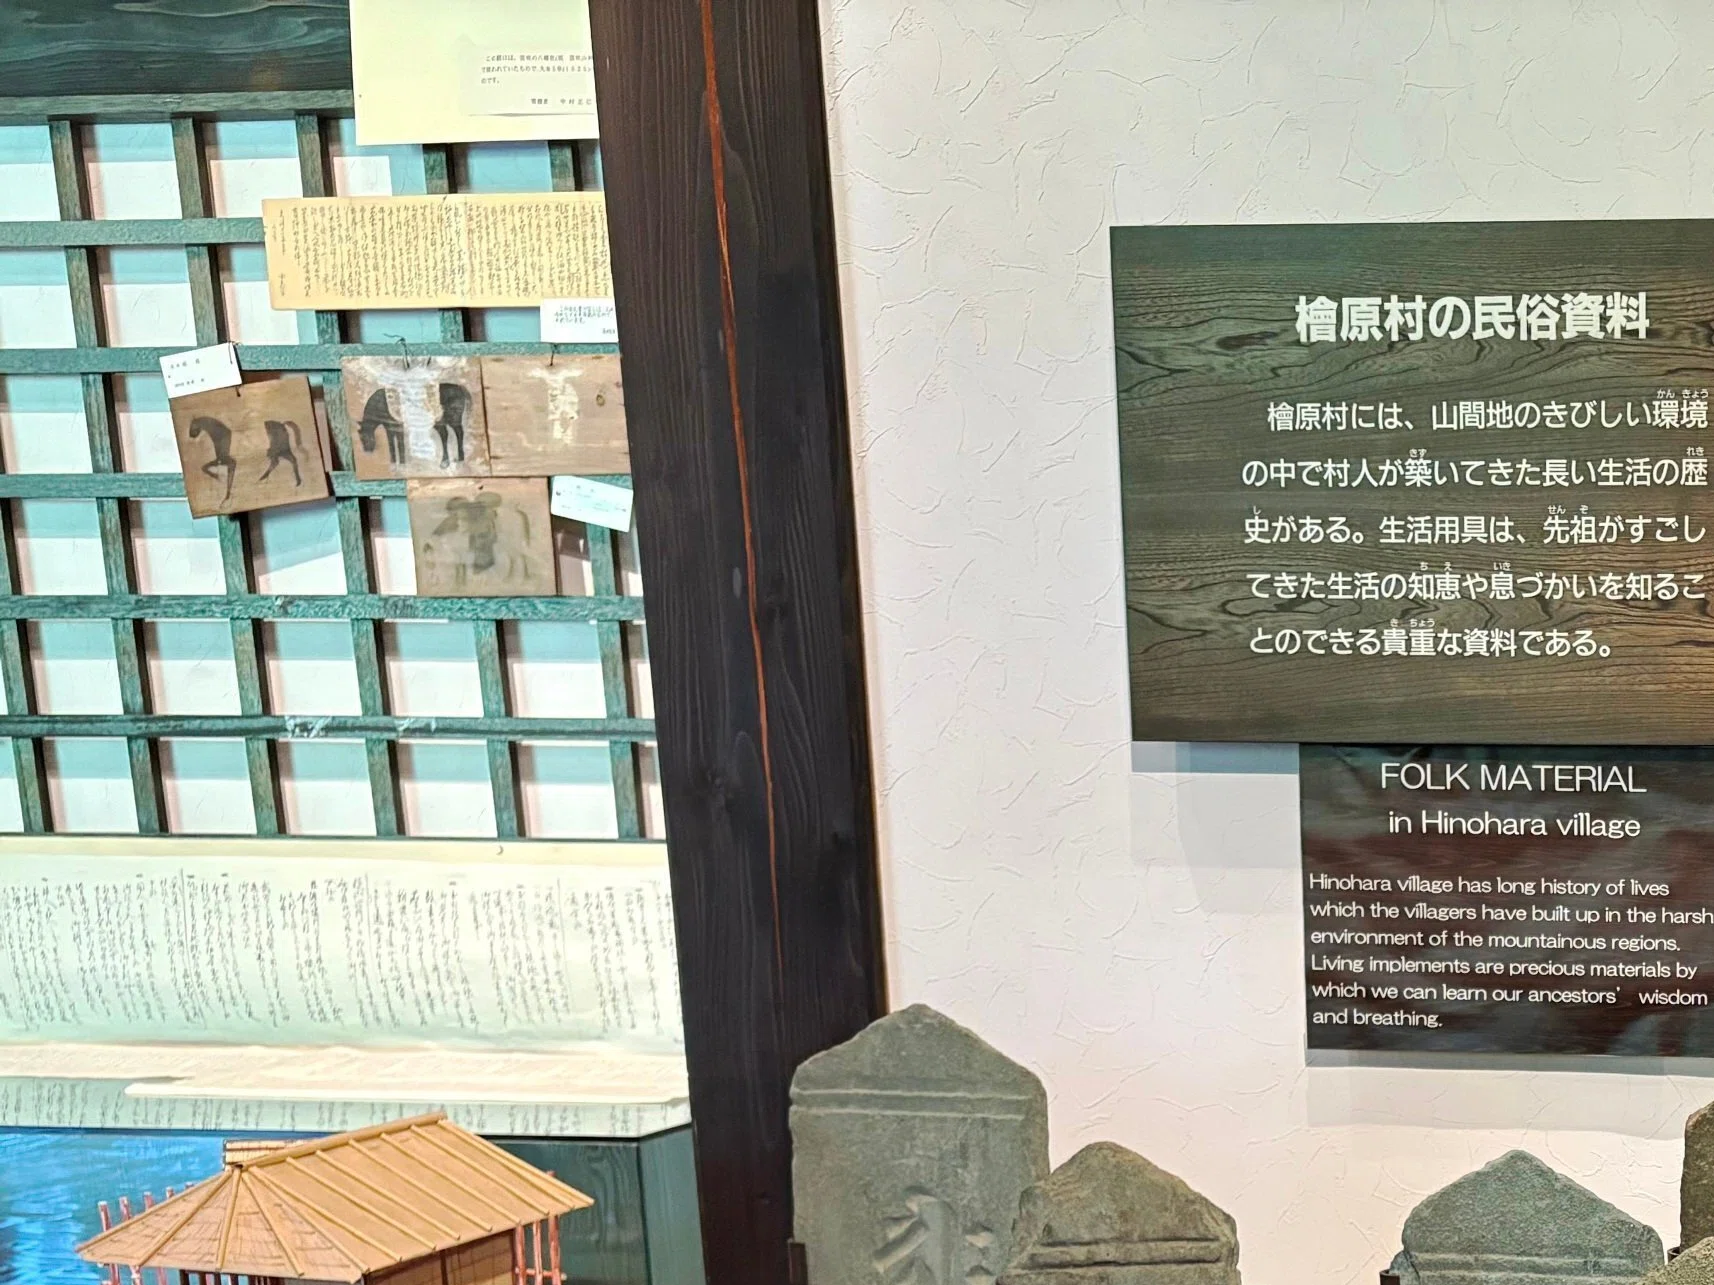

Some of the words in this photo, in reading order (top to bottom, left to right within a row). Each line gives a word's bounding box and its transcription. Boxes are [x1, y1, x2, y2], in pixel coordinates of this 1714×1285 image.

[1293, 292, 1650, 344] 檜原村の民俗資料
[1267, 400, 1708, 432] 檜原村には、山間地のきびしい環境
[1242, 457, 1708, 489] の中で村人が築いてきた長い生活の歴
[1243, 514, 1706, 546] 史がある。生活用具は、先祖がすごし
[1249, 570, 1706, 602] てきた生活の知恵や息づかいを知るこ
[1249, 626, 1612, 659] とのできる貴重な資料である。
[1381, 762, 1471, 792] FOLK
[1480, 764, 1648, 793] MATERIAL
[1389, 810, 1412, 834] in
[1421, 809, 1548, 836] Hinohara
[1555, 811, 1641, 840] village
[1309, 872, 1393, 891] Hinohara
[1396, 875, 1454, 894] village
[1458, 875, 1493, 894] has
[1496, 876, 1537, 896] long
[1540, 877, 1602, 897] history
[1605, 878, 1626, 896] of
[1629, 878, 1670, 897] lives
[1309, 900, 1365, 918] which
[1369, 901, 1400, 919] the
[1404, 902, 1477, 921] villagers
[1481, 903, 1528, 922] have
[1531, 904, 1571, 922] built
[1575, 910, 1601, 924] up
[1605, 906, 1621, 923] in
[1626, 906, 1657, 924] the
[1661, 906, 1714, 925] harsh
[1310, 928, 1425, 946] environment
[1428, 929, 1448, 947] of
[1453, 930, 1484, 948] the
[1488, 933, 1607, 950] mountainous
[1611, 934, 1681, 952] regions.
[1311, 953, 1365, 973] Living
[1369, 955, 1471, 974] implements
[1474, 961, 1505, 974] are
[1509, 959, 1586, 977] precious
[1590, 960, 1672, 978] materials
[1676, 961, 1698, 980] by
[1311, 980, 1366, 998] which
[1370, 985, 1399, 999] we
[1402, 986, 1438, 1000] can
[1441, 982, 1488, 1001] learn
[1491, 988, 1524, 1002] our
[1638, 988, 1708, 1006] wisdom
[1312, 1007, 1348, 1025] and
[1352, 1008, 1443, 1029] breathing.
